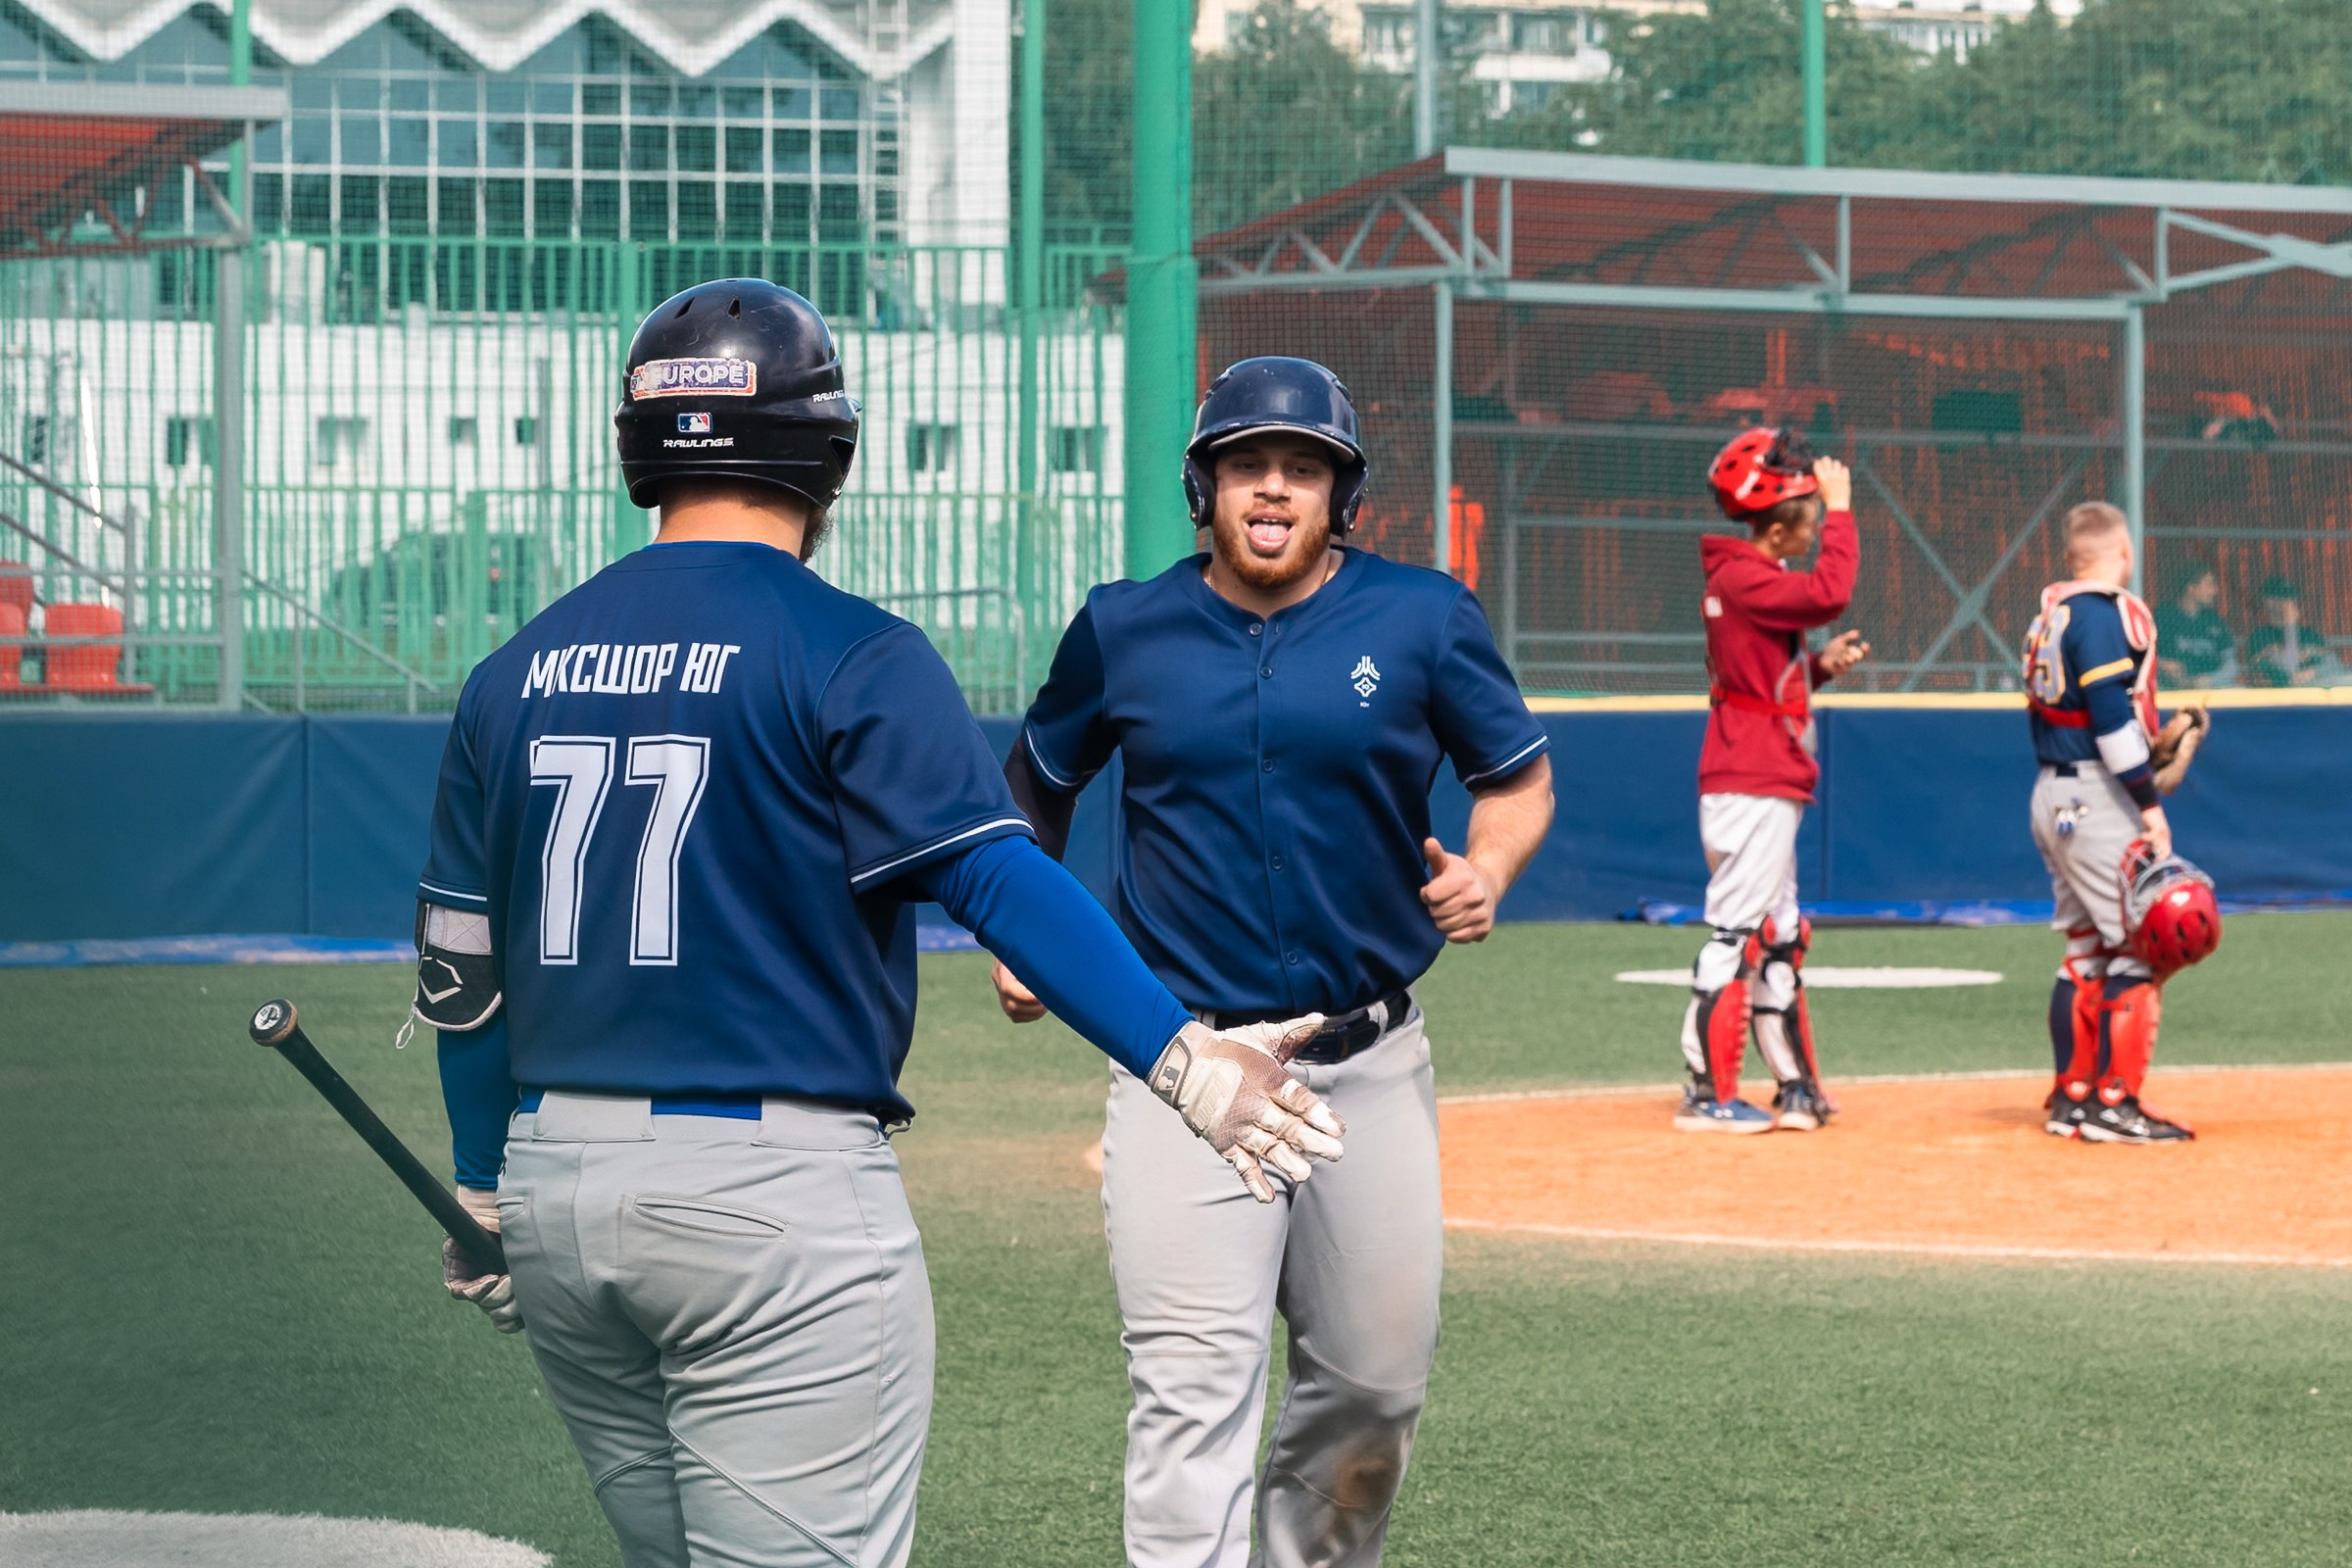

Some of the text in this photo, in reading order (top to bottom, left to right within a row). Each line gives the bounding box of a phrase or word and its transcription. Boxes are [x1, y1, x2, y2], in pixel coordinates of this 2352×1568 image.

[662, 437, 734, 448] RAWLINGS
[521, 642, 741, 699] МКСШОР ЮГ
[530, 735, 710, 966] 77
